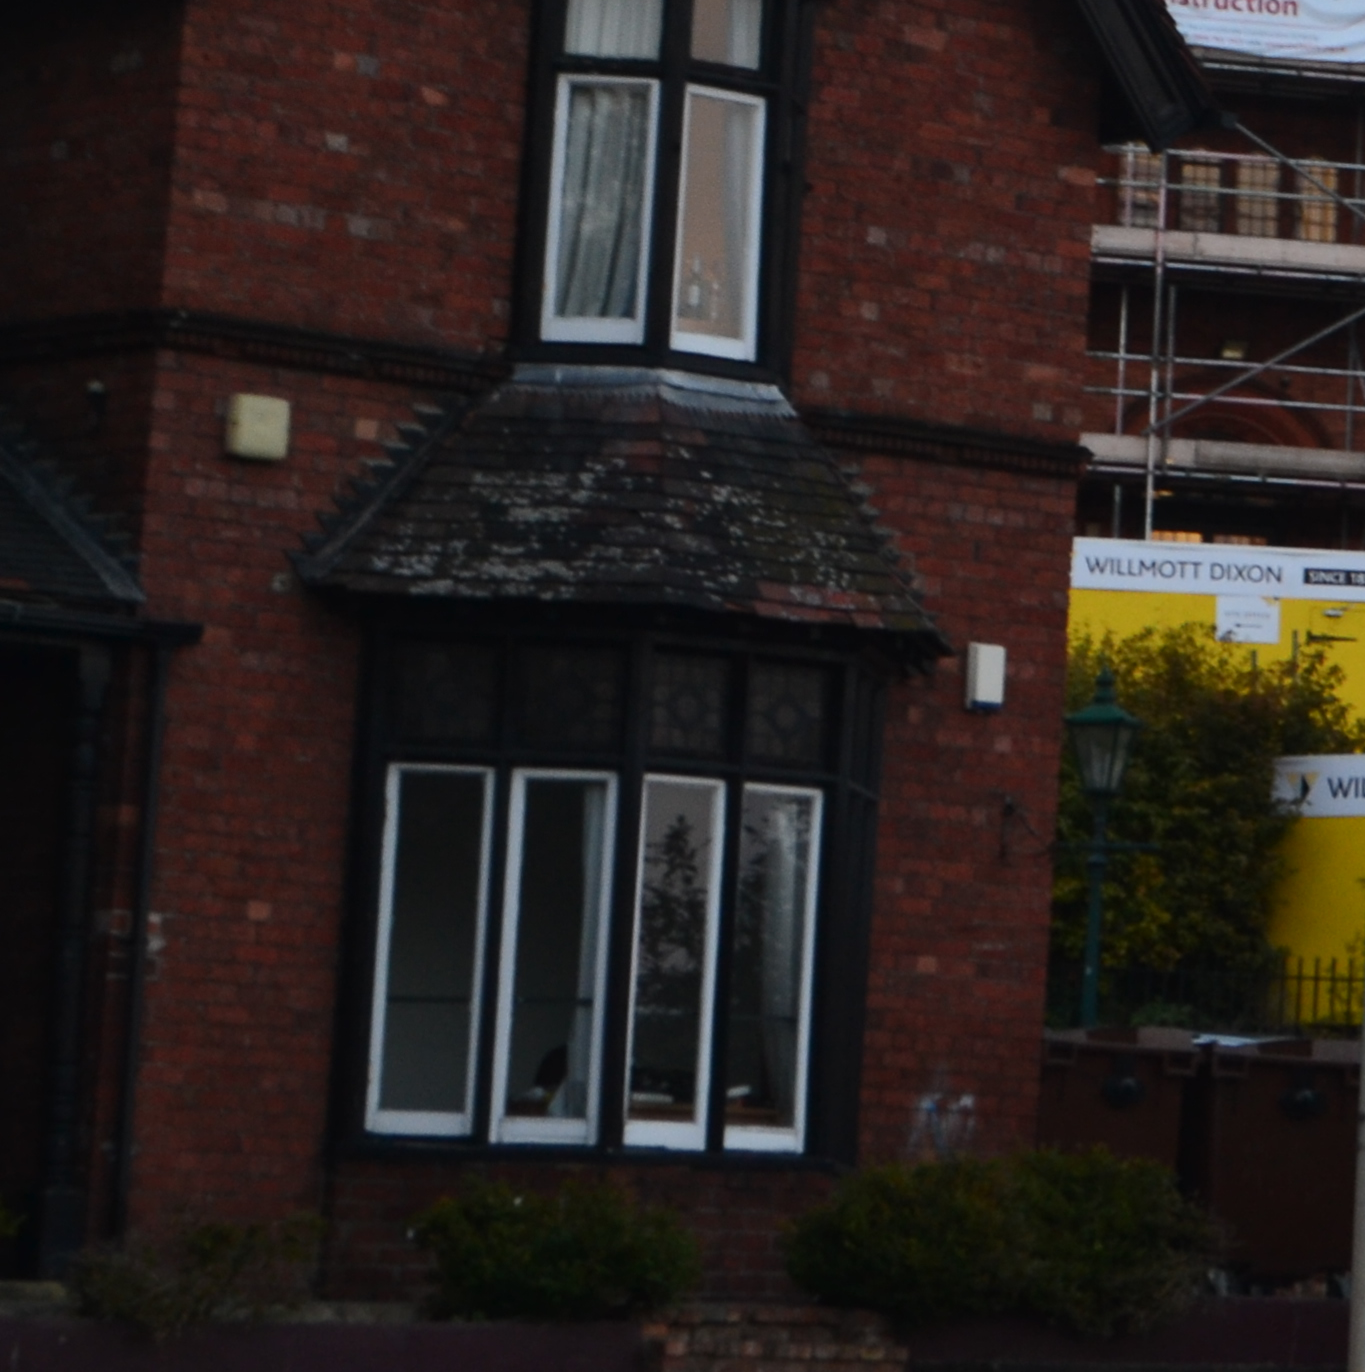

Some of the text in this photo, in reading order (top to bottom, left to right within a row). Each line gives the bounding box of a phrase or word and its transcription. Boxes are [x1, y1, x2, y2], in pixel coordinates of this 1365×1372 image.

[1084, 556, 1203, 579] WILLMOTT
[1209, 562, 1283, 584] DIXON
[1308, 570, 1346, 584] SINCE
